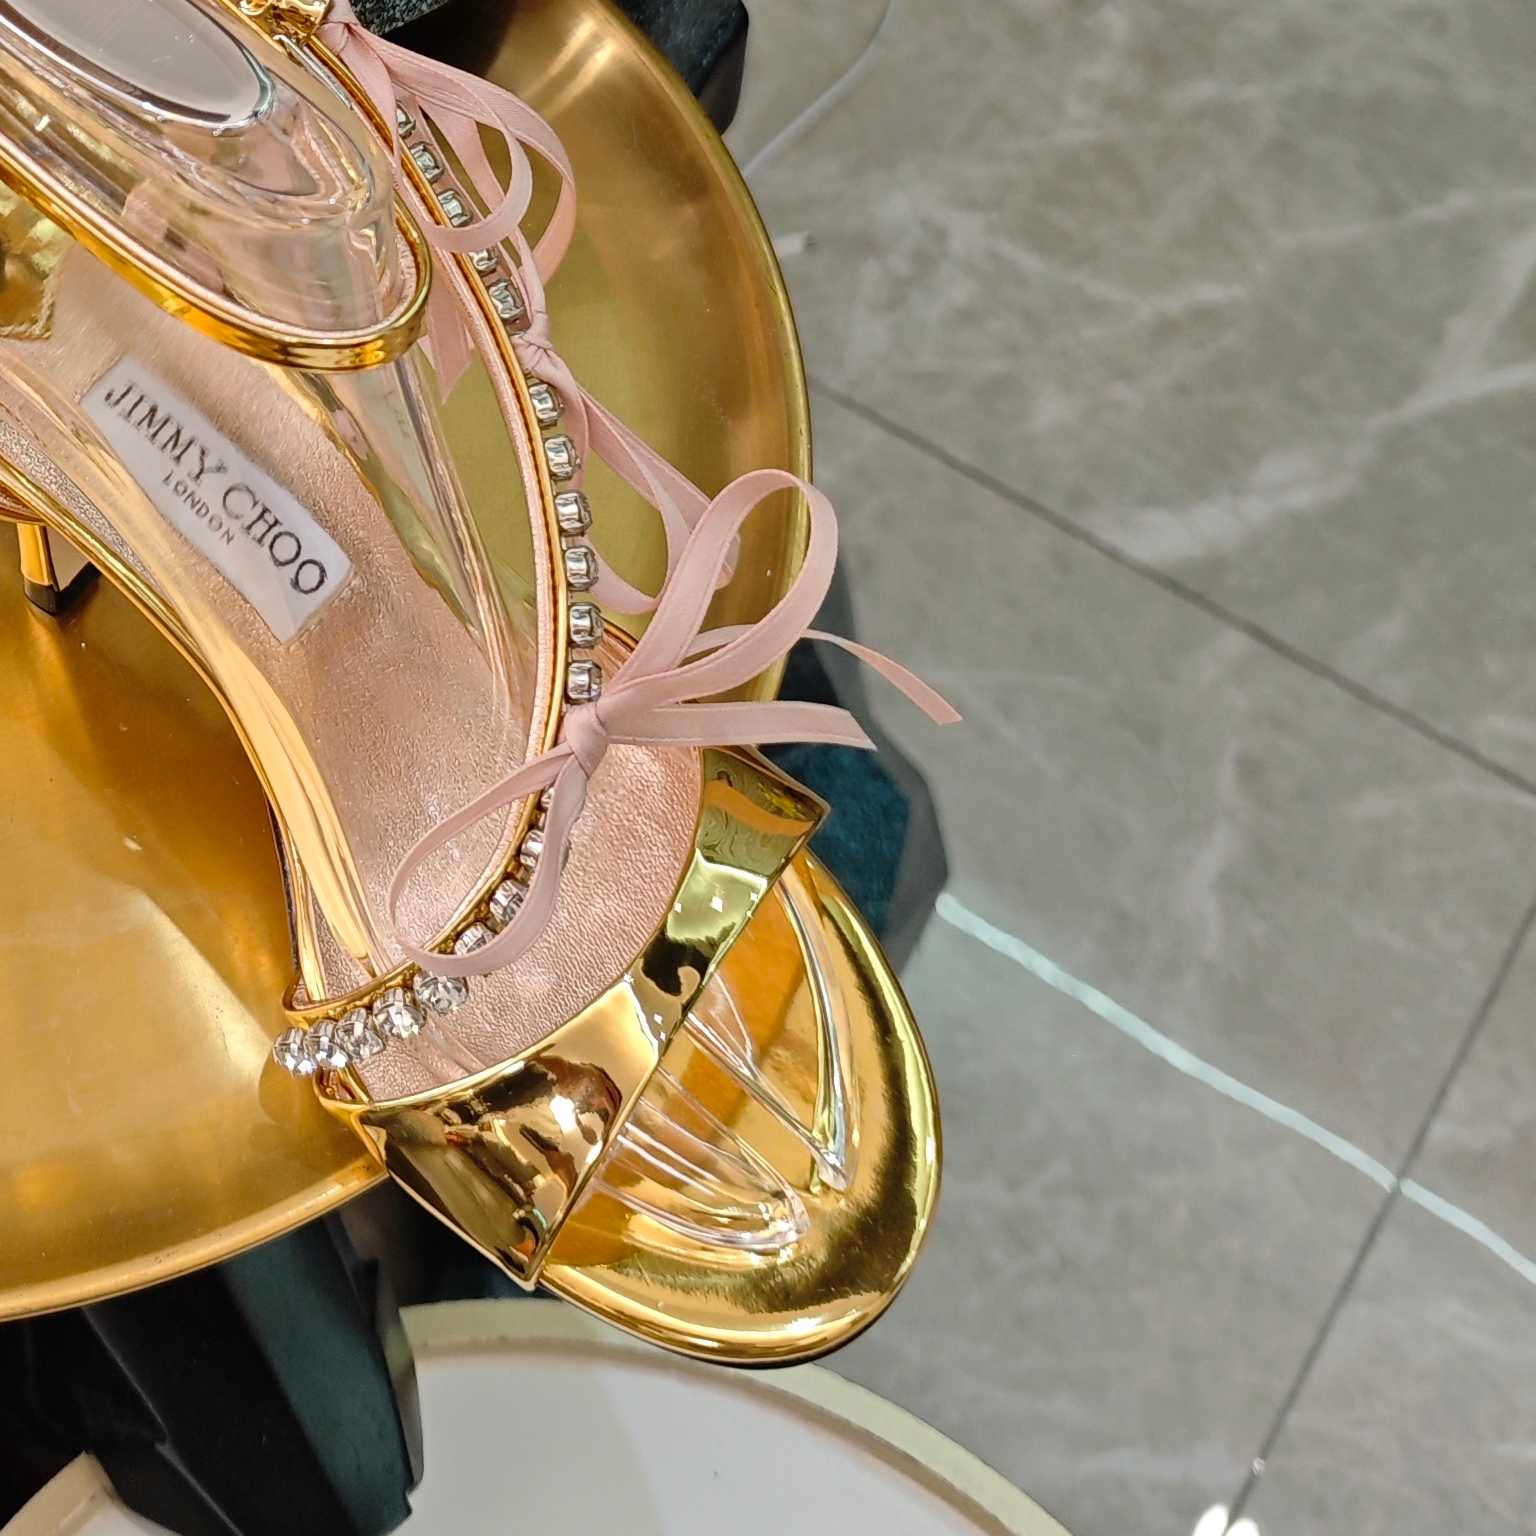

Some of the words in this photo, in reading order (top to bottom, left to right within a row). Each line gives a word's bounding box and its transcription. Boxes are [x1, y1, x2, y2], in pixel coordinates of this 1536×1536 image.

[103, 382, 229, 487] JIMMY
[221, 481, 329, 595] CHOO
[162, 468, 236, 547] LONDON
